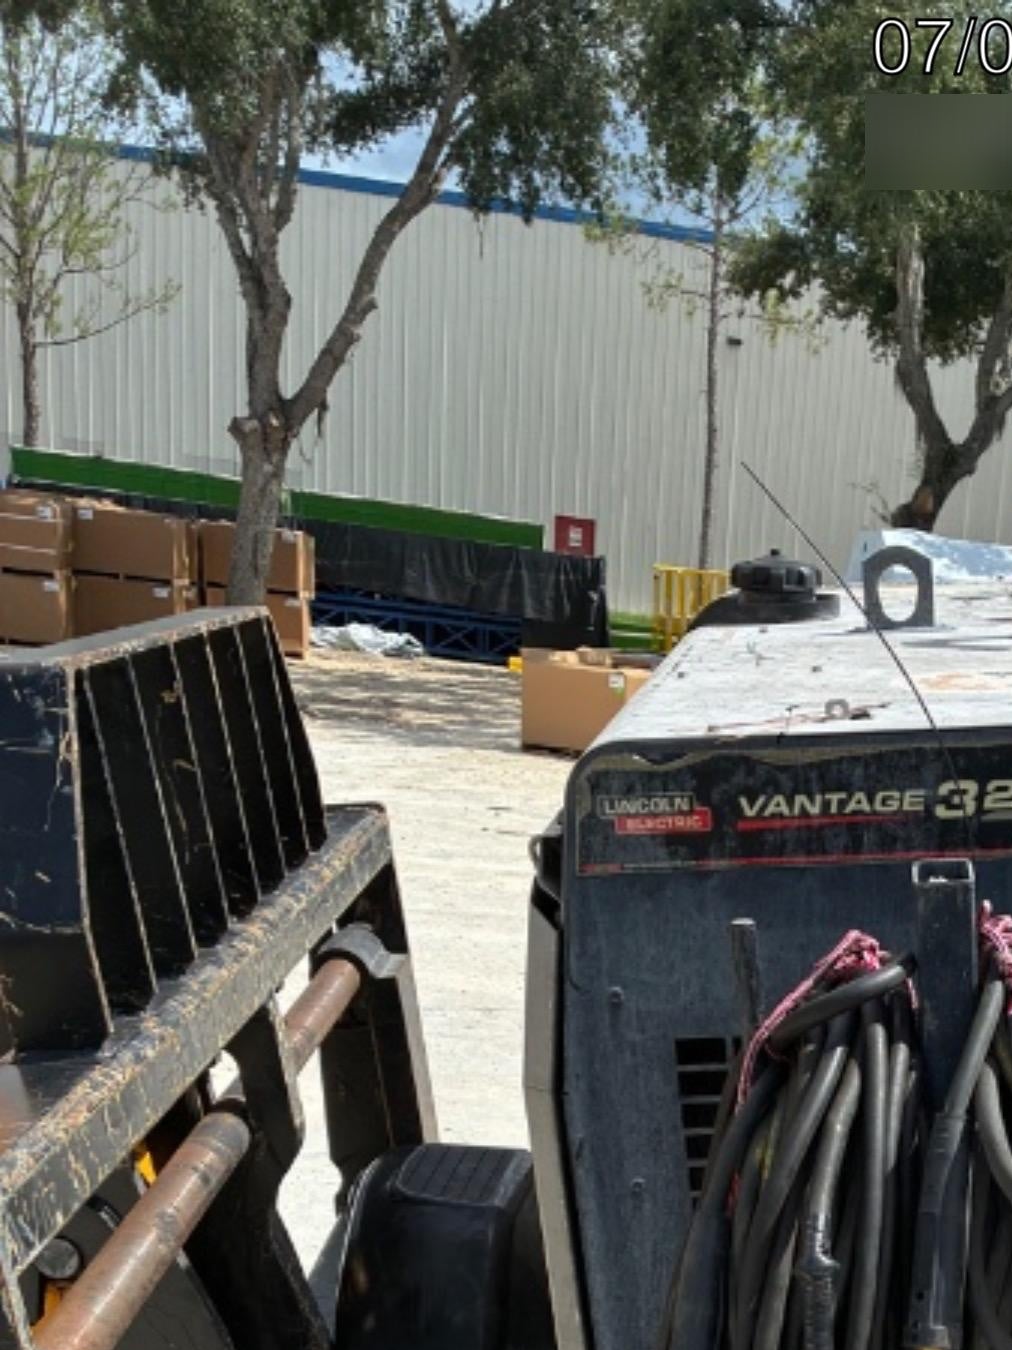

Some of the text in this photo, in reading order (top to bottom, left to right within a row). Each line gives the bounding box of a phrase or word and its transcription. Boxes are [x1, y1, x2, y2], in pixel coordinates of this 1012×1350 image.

[604, 796, 691, 814] LINCOLN
[738, 789, 926, 817] VANTAGE
[625, 815, 703, 830] ELECTRIC
